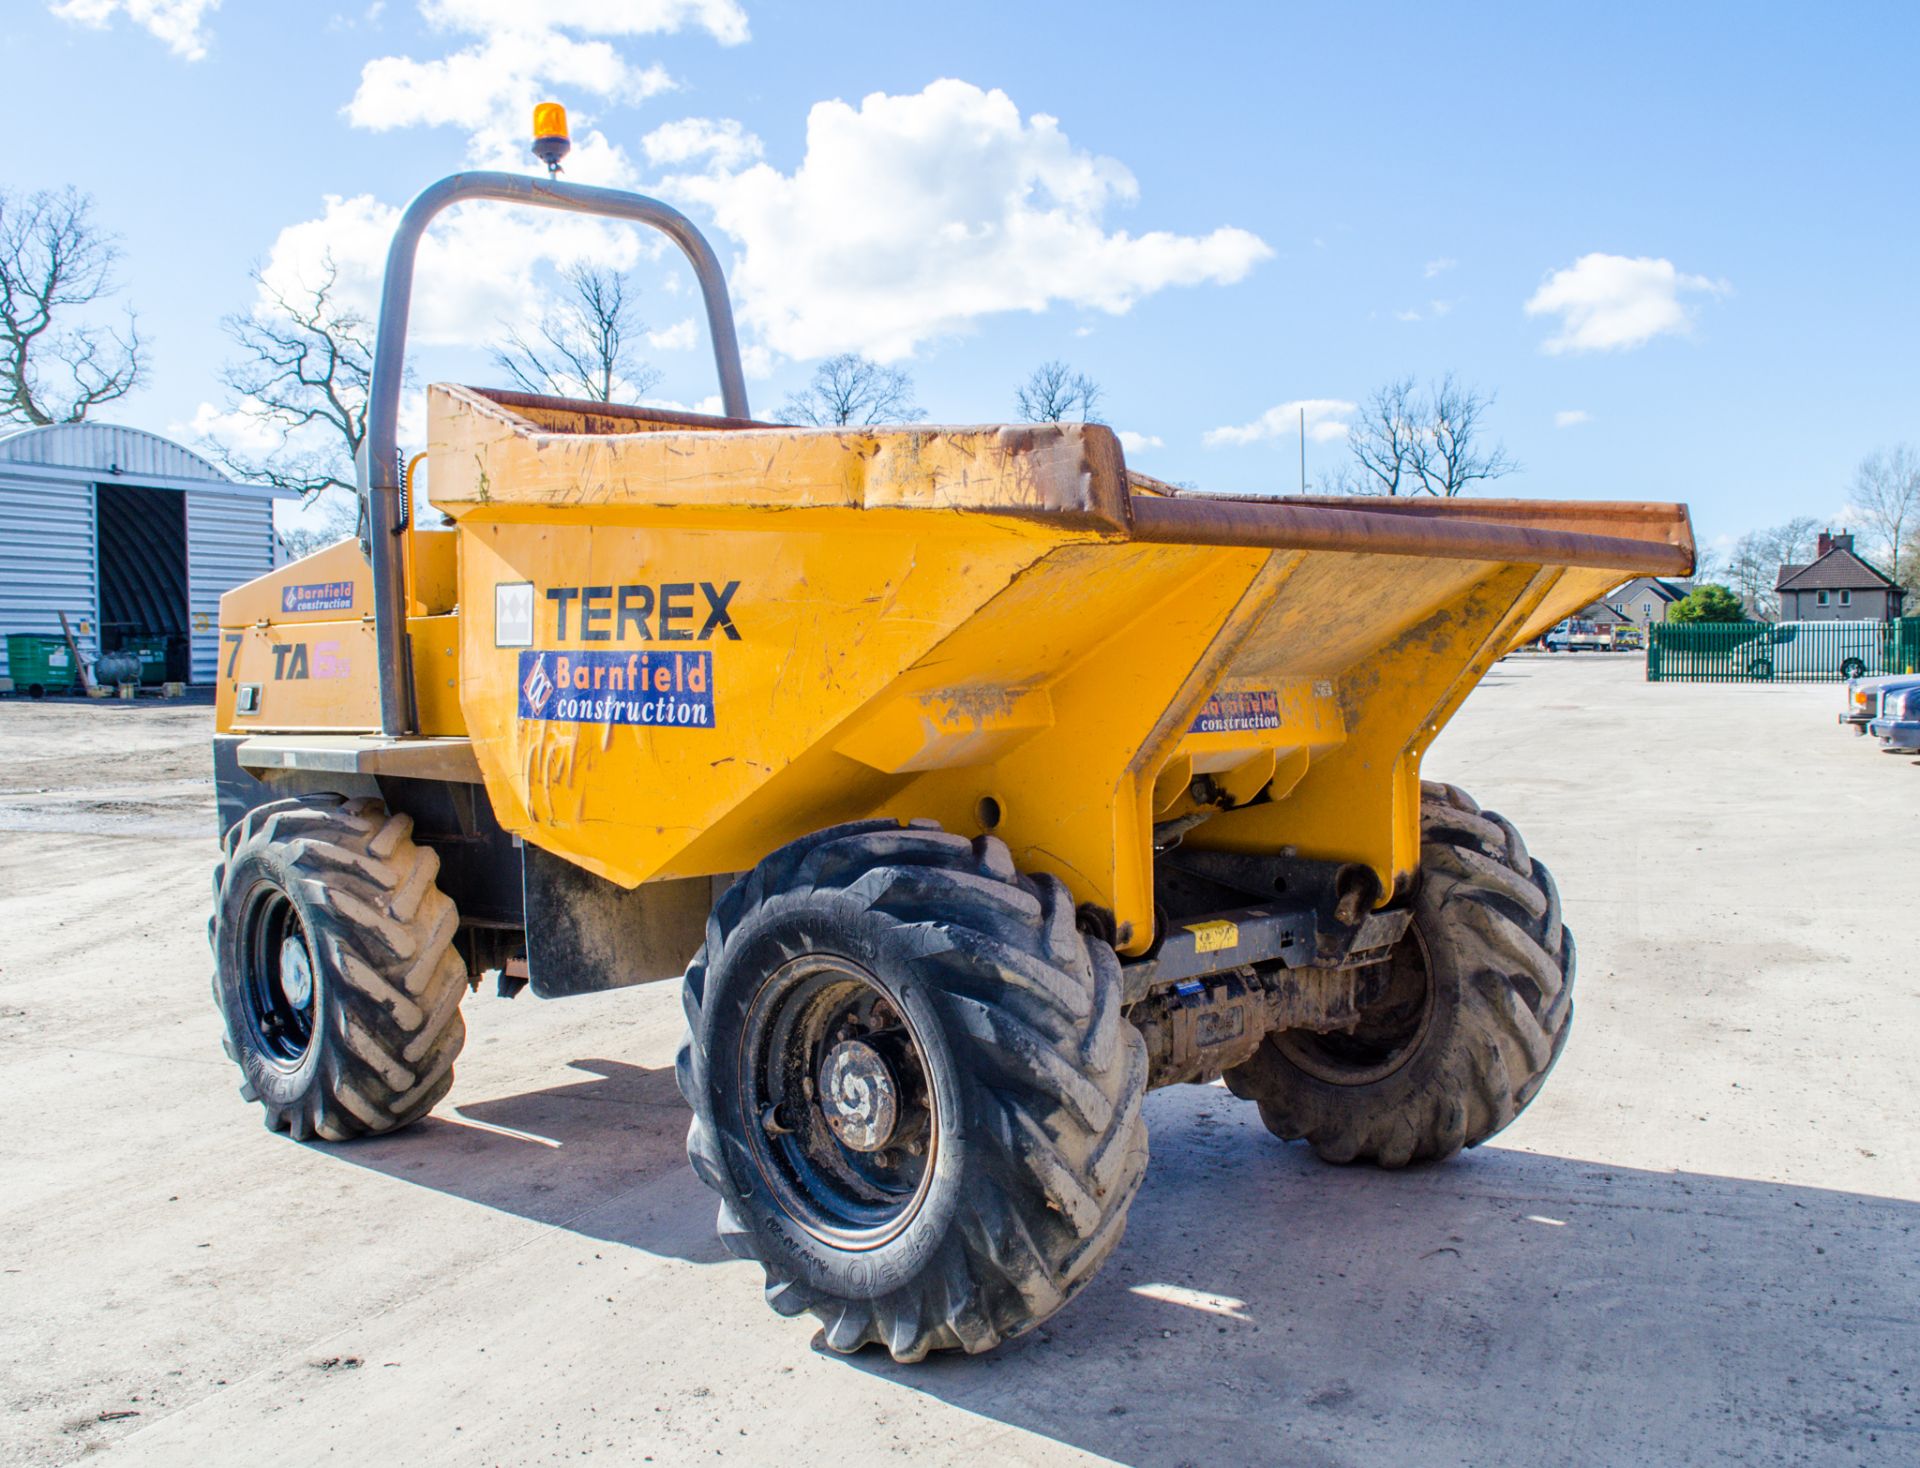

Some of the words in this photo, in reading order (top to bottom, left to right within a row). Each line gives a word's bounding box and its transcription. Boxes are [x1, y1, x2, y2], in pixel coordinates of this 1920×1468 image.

[297, 583, 352, 599] Barnfield
[297, 599, 351, 611] construction
[546, 581, 742, 641] TEREX
[225, 634, 243, 678] 7
[556, 654, 706, 693] Barnfield
[557, 695, 708, 725] construction
[1202, 713, 1278, 731] construction
